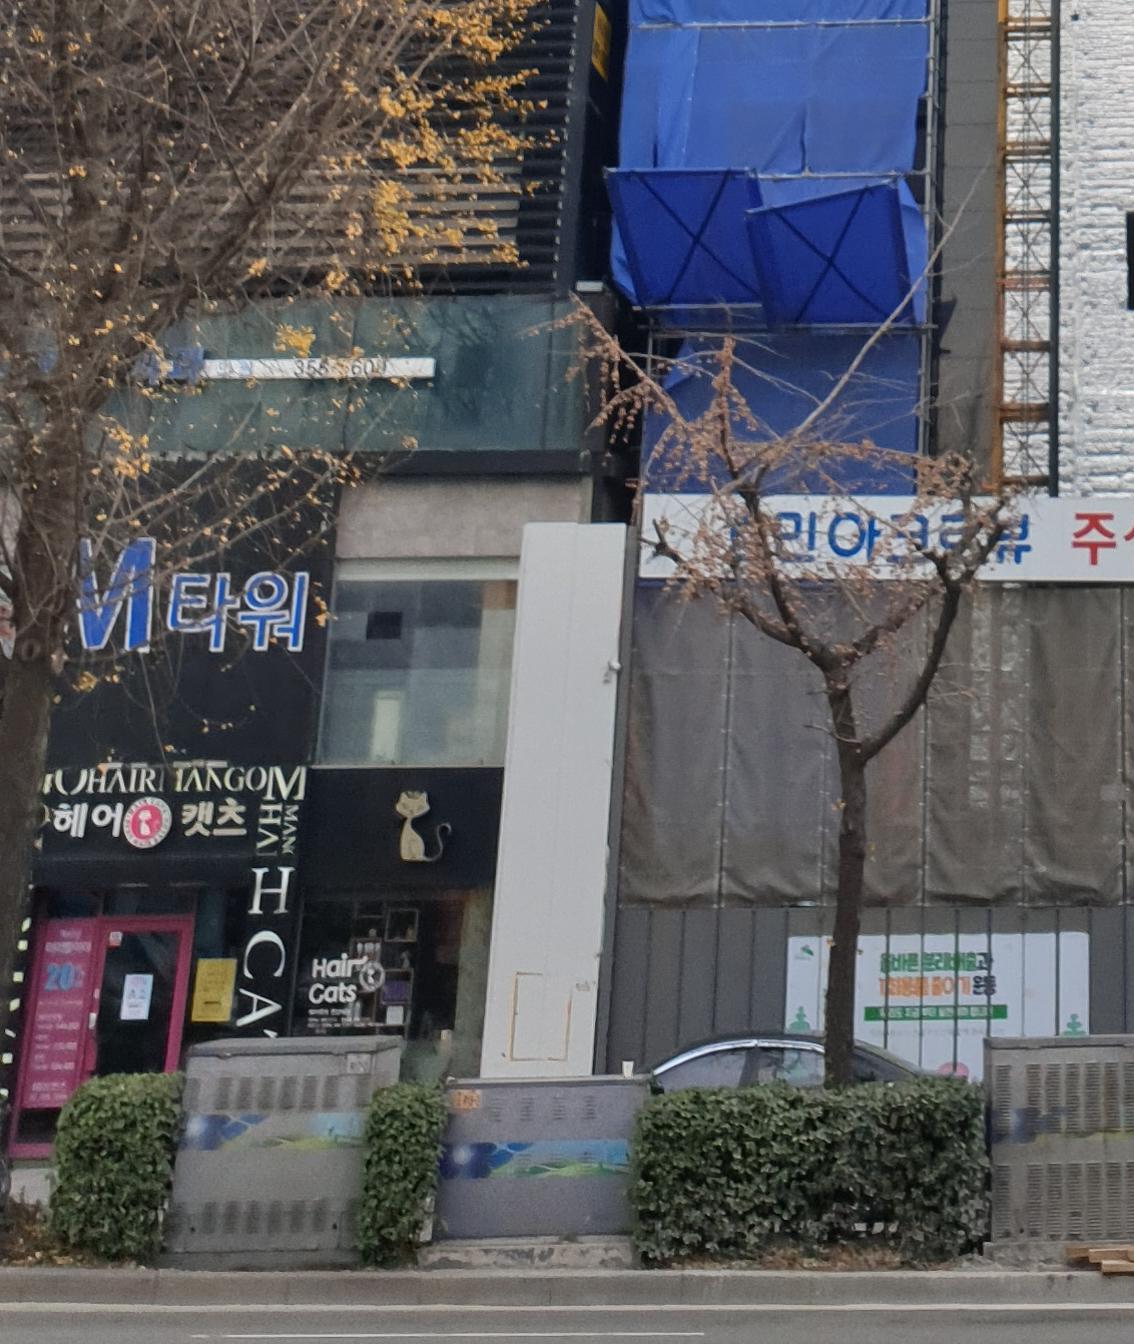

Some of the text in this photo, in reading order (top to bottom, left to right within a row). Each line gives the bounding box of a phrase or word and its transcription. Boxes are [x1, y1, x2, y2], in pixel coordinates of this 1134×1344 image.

[52, 802, 125, 839] 헤어
[311, 952, 368, 979] Hair
[308, 981, 358, 1005] Cats
